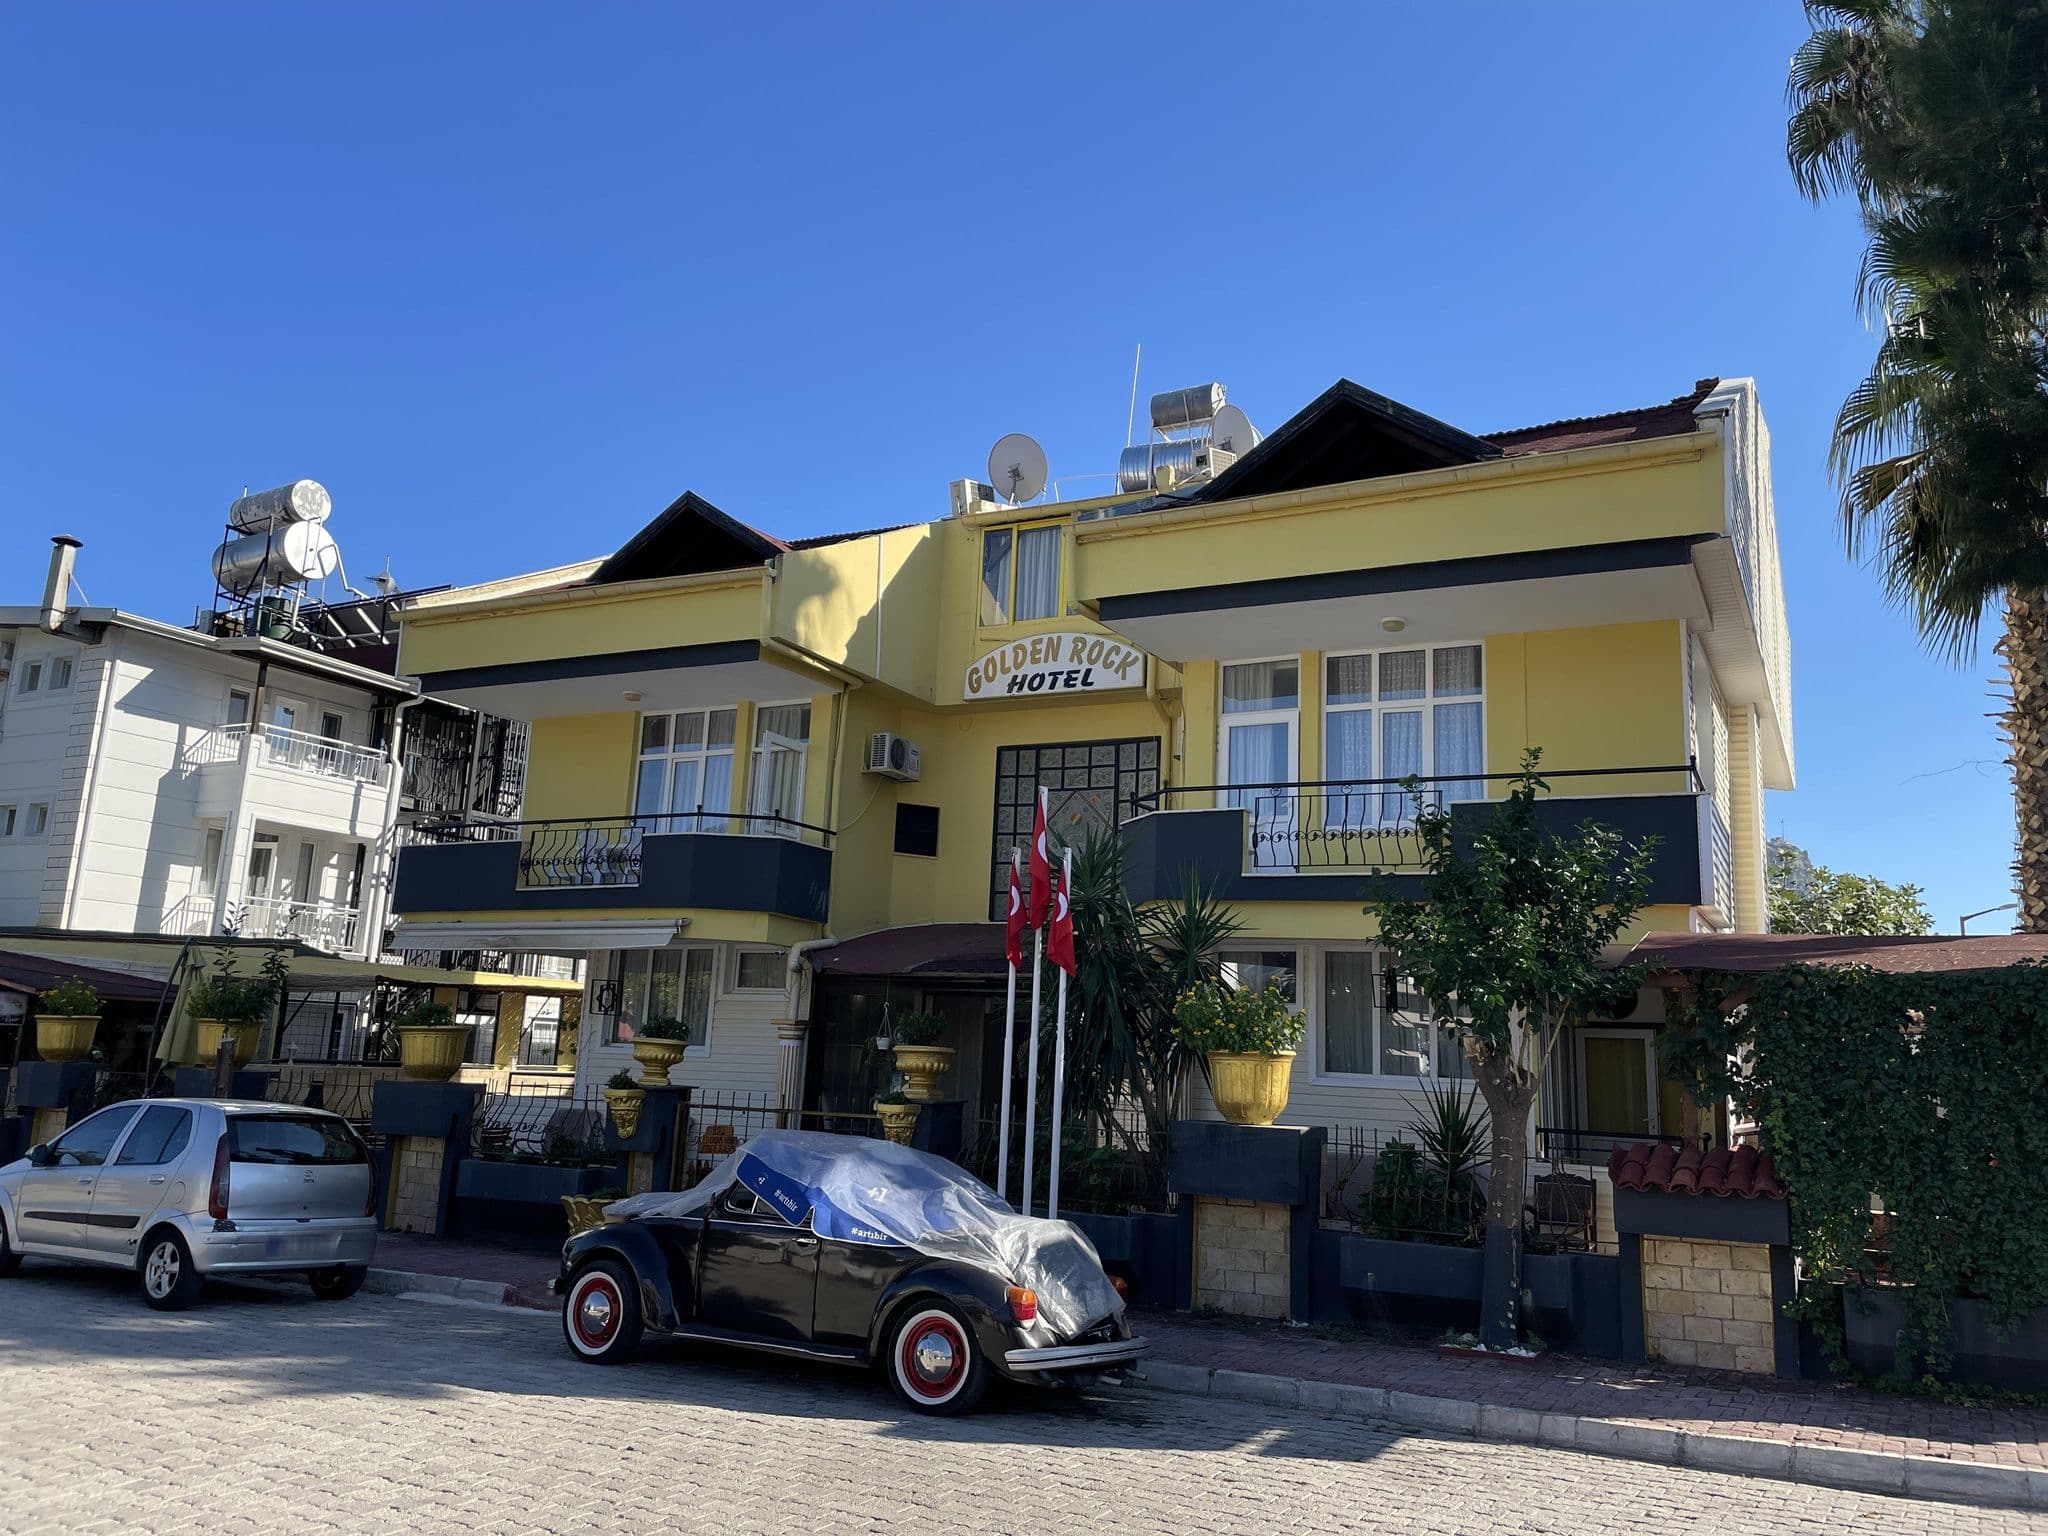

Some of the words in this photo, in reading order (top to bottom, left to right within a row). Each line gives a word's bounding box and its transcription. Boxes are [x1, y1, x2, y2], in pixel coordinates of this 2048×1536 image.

[968, 635, 1062, 694] GOLDEN
[1069, 636, 1140, 681] ROCK
[1006, 668, 1095, 694] HOTEL
